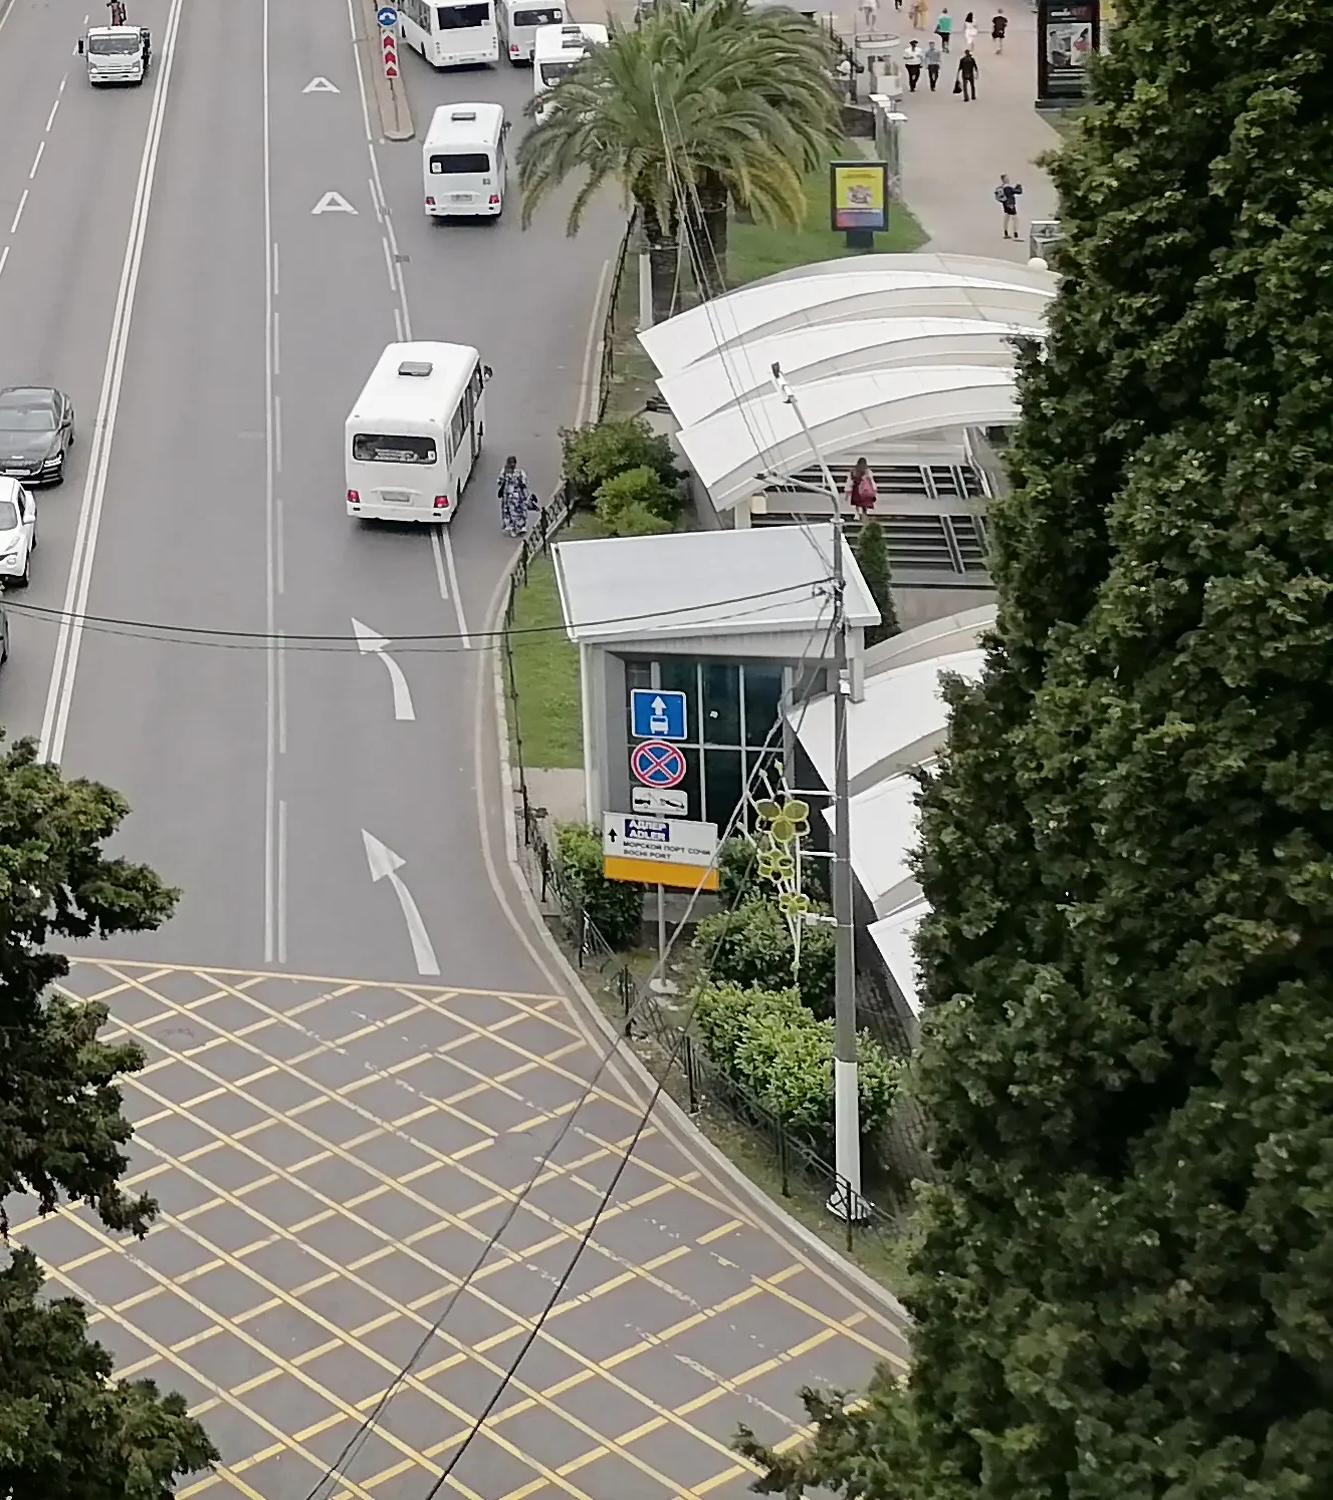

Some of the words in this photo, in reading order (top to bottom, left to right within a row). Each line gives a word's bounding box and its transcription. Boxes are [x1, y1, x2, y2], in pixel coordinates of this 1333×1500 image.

[629, 820, 666, 831] АДЛЕР
[629, 829, 666, 841] ADLER
[664, 845, 685, 853] ПОРТ
[688, 848, 711, 856] СОЧИ
